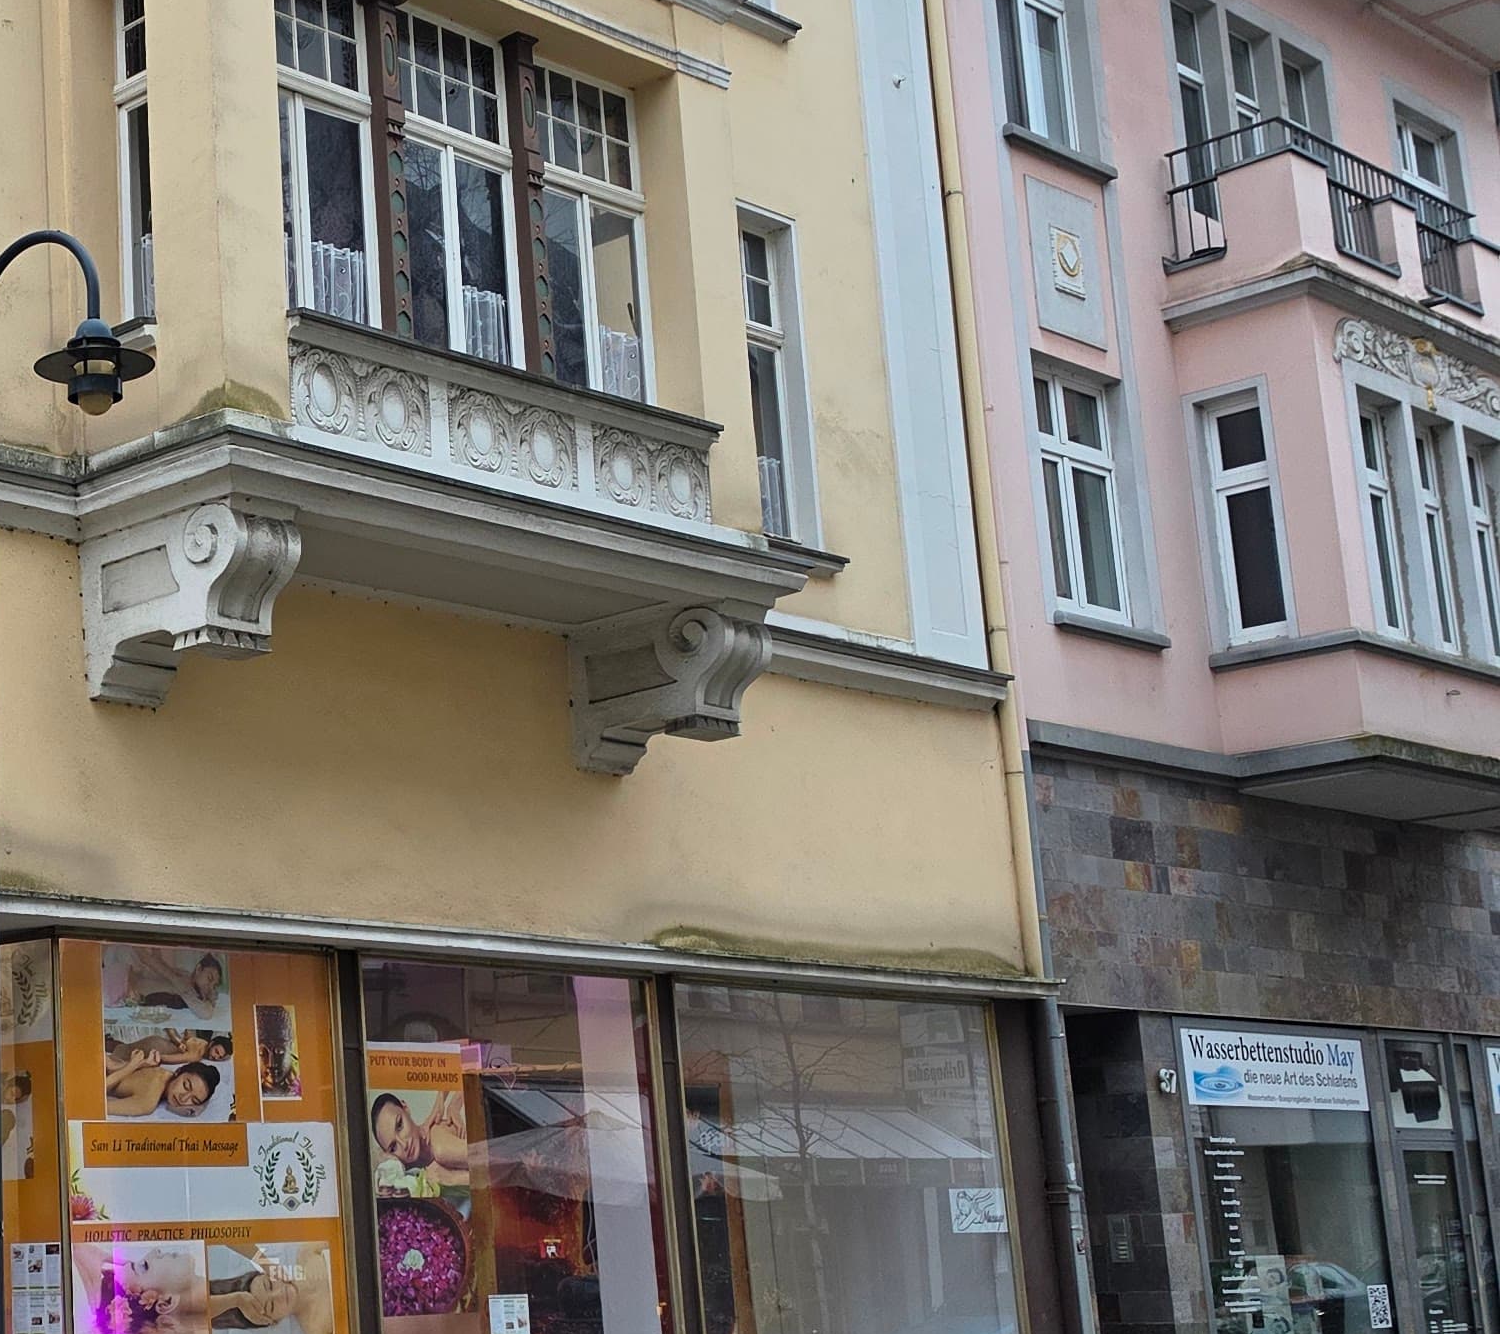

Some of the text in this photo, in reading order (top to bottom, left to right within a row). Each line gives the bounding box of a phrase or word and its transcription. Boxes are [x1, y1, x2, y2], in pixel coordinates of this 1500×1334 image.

[369, 1055, 446, 1068] PUT YOUR BODY IN
[1188, 1034, 1355, 1074] Wasserbettenstudio May
[406, 1071, 459, 1083] GOOD HANDS
[1243, 1069, 1358, 1089] die neue Art des Schlafens
[112, 1138, 122, 1152] Li
[125, 1137, 177, 1152] Traditional
[178, 1137, 199, 1152] Thai
[202, 1139, 239, 1157] Massage
[83, 1226, 252, 1242] HOLISTIC PRACTICE PHILOSOPHY
